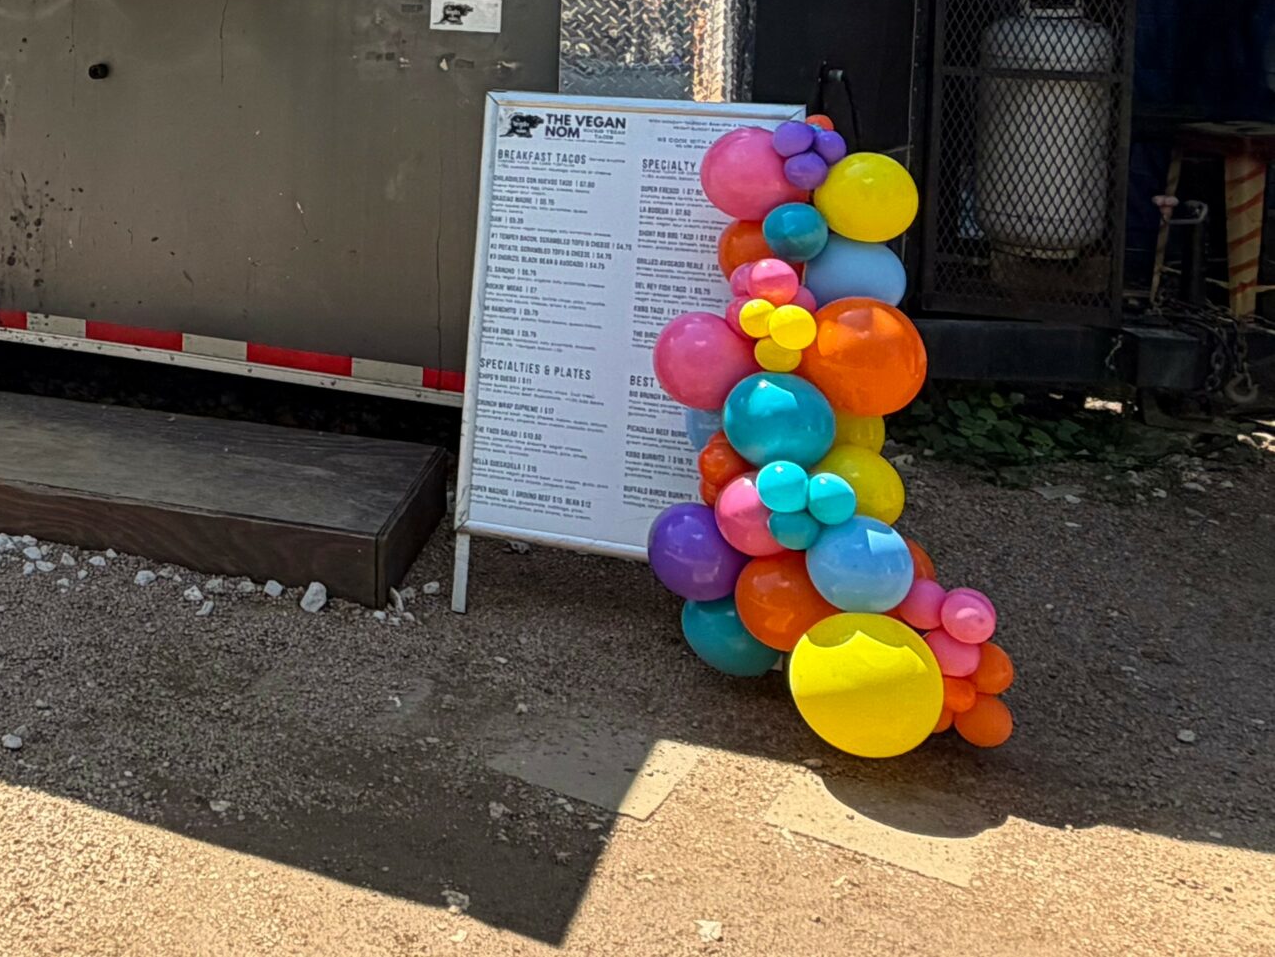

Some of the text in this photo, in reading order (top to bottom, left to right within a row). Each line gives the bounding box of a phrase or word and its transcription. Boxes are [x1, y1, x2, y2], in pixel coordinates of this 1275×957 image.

[545, 113, 626, 129] THE VEGAN
[545, 126, 580, 139] NOM
[497, 149, 587, 164] BREAKFAST TACOS
[642, 158, 697, 172] SPECIALTY
[479, 357, 591, 381] SPECIALTIES & PLATES
[629, 375, 654, 388] BEST
